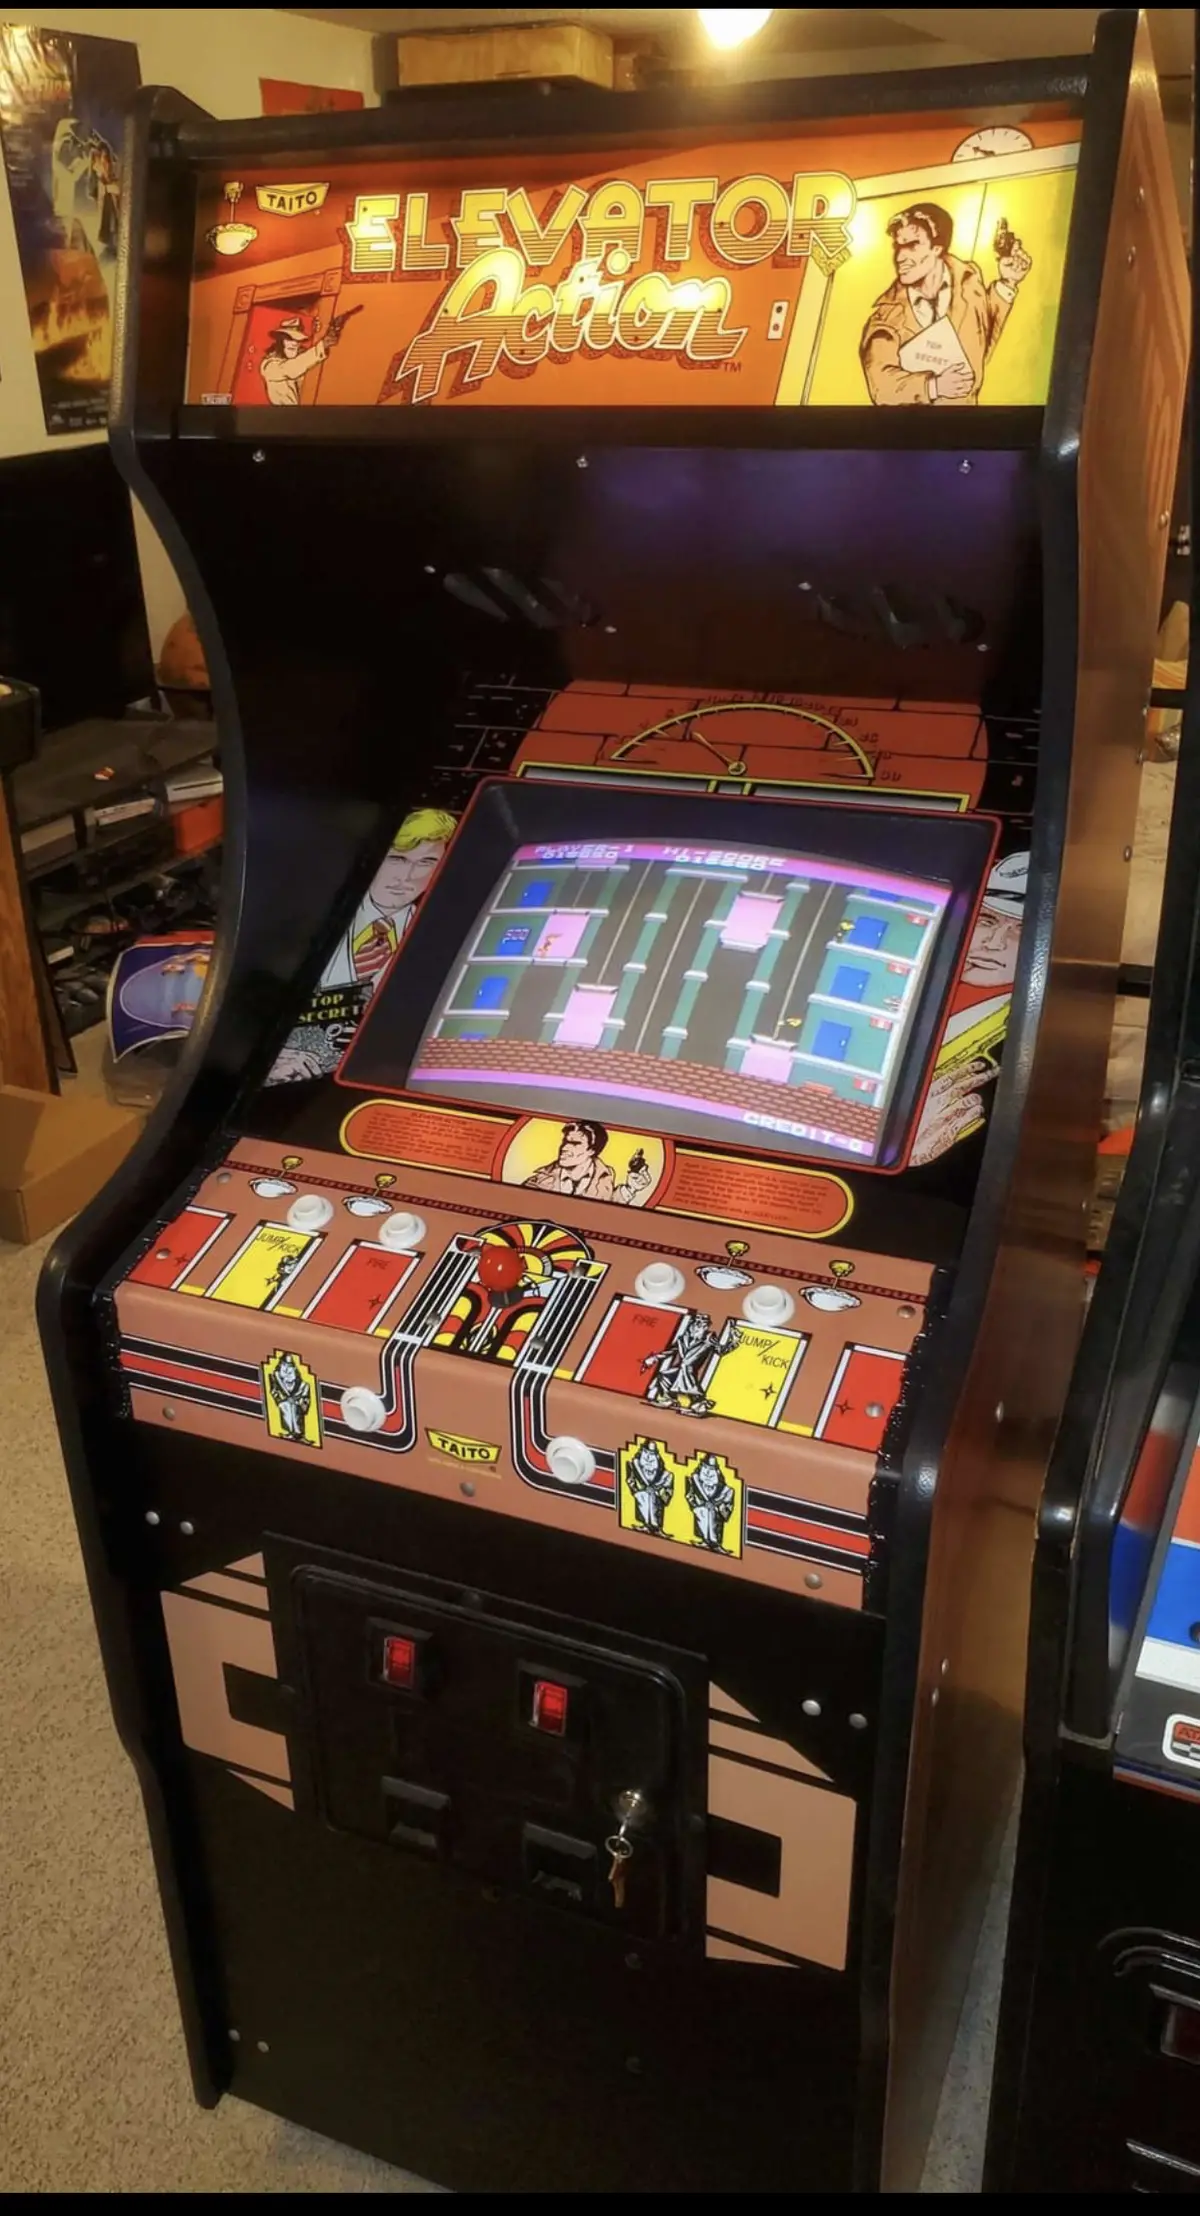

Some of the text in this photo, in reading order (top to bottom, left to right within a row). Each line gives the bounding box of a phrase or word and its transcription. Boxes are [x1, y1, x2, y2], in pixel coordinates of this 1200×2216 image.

[266, 190, 318, 212] TAITO
[342, 171, 858, 274] ELEVATOR
[394, 245, 750, 405] Action
[311, 992, 344, 1008] TOP
[298, 1004, 360, 1022] SECRET
[366, 1256, 391, 1270] FIRE
[632, 1313, 660, 1328] FIRE
[761, 1355, 791, 1370] KICK
[438, 1437, 490, 1459] TAITO
